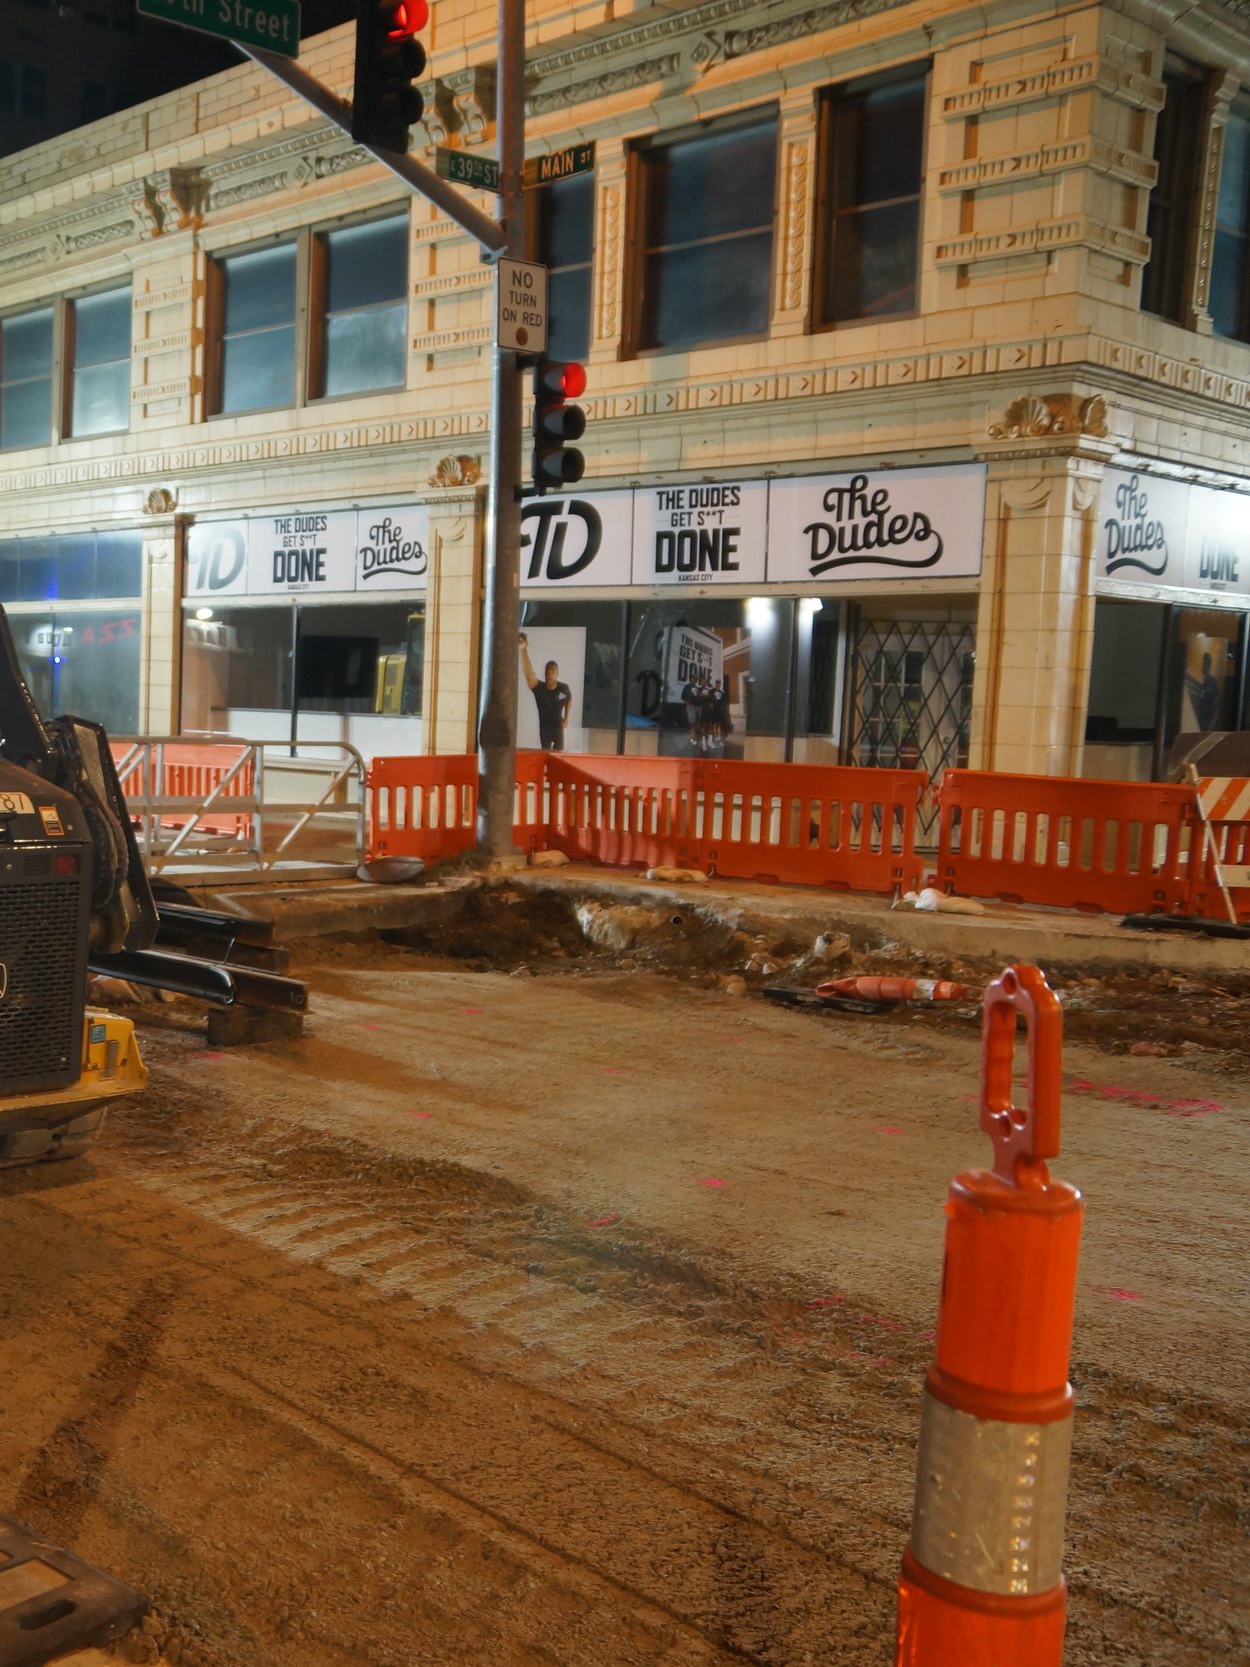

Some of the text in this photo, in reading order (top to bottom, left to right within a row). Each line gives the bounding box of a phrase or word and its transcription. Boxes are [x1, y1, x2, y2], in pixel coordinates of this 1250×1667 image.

[218, 0, 291, 42] Street
[484, 163, 498, 185] ST
[541, 150, 591, 179] MAIN ST
[512, 270, 533, 289] NO
[509, 290, 537, 308] TURN
[502, 308, 543, 327] ON RED
[656, 485, 741, 511] THE DUDES
[823, 474, 892, 522] The
[1116, 474, 1148, 521] The
[273, 516, 328, 534] THE DUDES
[369, 517, 403, 546] The
[670, 511, 693, 528] GET
[283, 535, 299, 547] GET
[655, 527, 741, 573] DONE
[803, 511, 937, 563] Dudes
[1104, 517, 1166, 560] Dudes
[272, 548, 327, 584] DONE
[359, 540, 426, 572] Dudes
[678, 573, 713, 582] KANSAS CITY
[679, 645, 696, 660] GET
[677, 658, 713, 687] DONE
